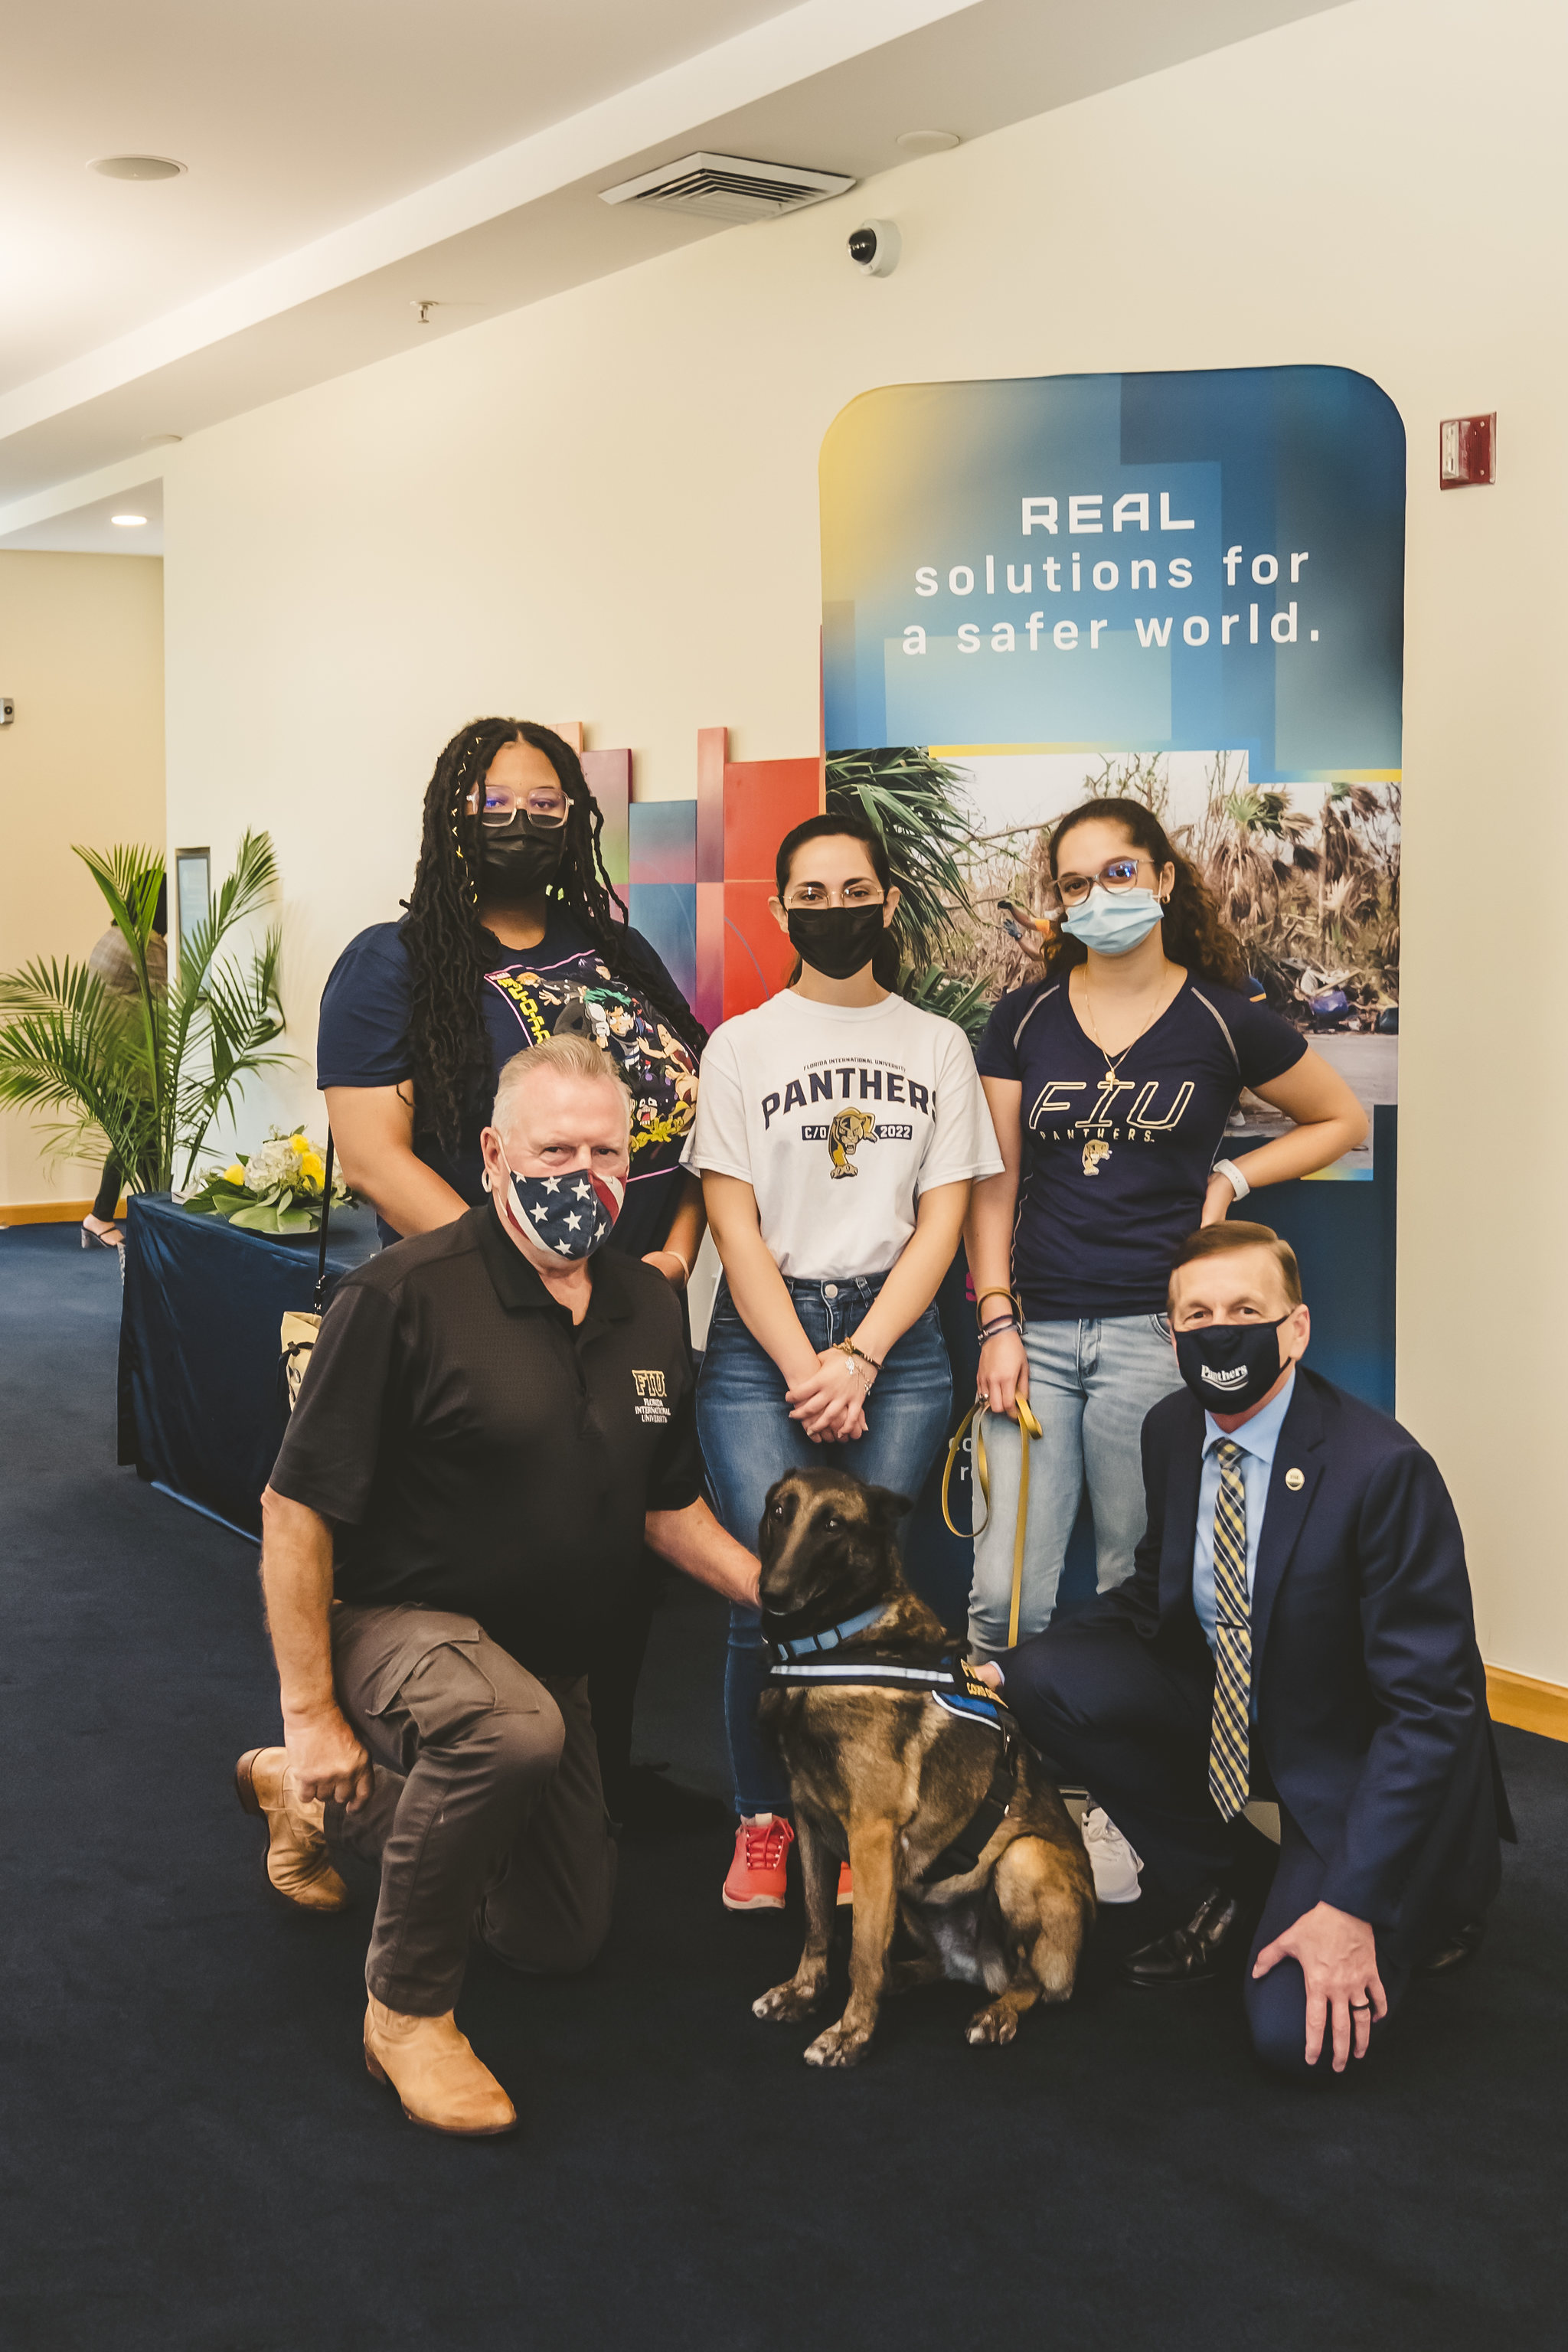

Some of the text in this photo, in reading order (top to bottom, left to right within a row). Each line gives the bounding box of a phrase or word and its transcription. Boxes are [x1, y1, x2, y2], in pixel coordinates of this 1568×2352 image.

[1021, 492, 1195, 536] REAL
[914, 545, 1309, 597] solutions for
[902, 602, 1319, 655] a safer world.
[804, 1060, 828, 1071] FLORIDA
[874, 1059, 906, 1072] UNIVERSITY
[1029, 1081, 1194, 1130] FIU
[880, 1125, 910, 1138] 2022
[1040, 1128, 1152, 1142] PANTHERS
[632, 1369, 667, 1397] FIU
[1201, 1364, 1248, 1381] Panthers
